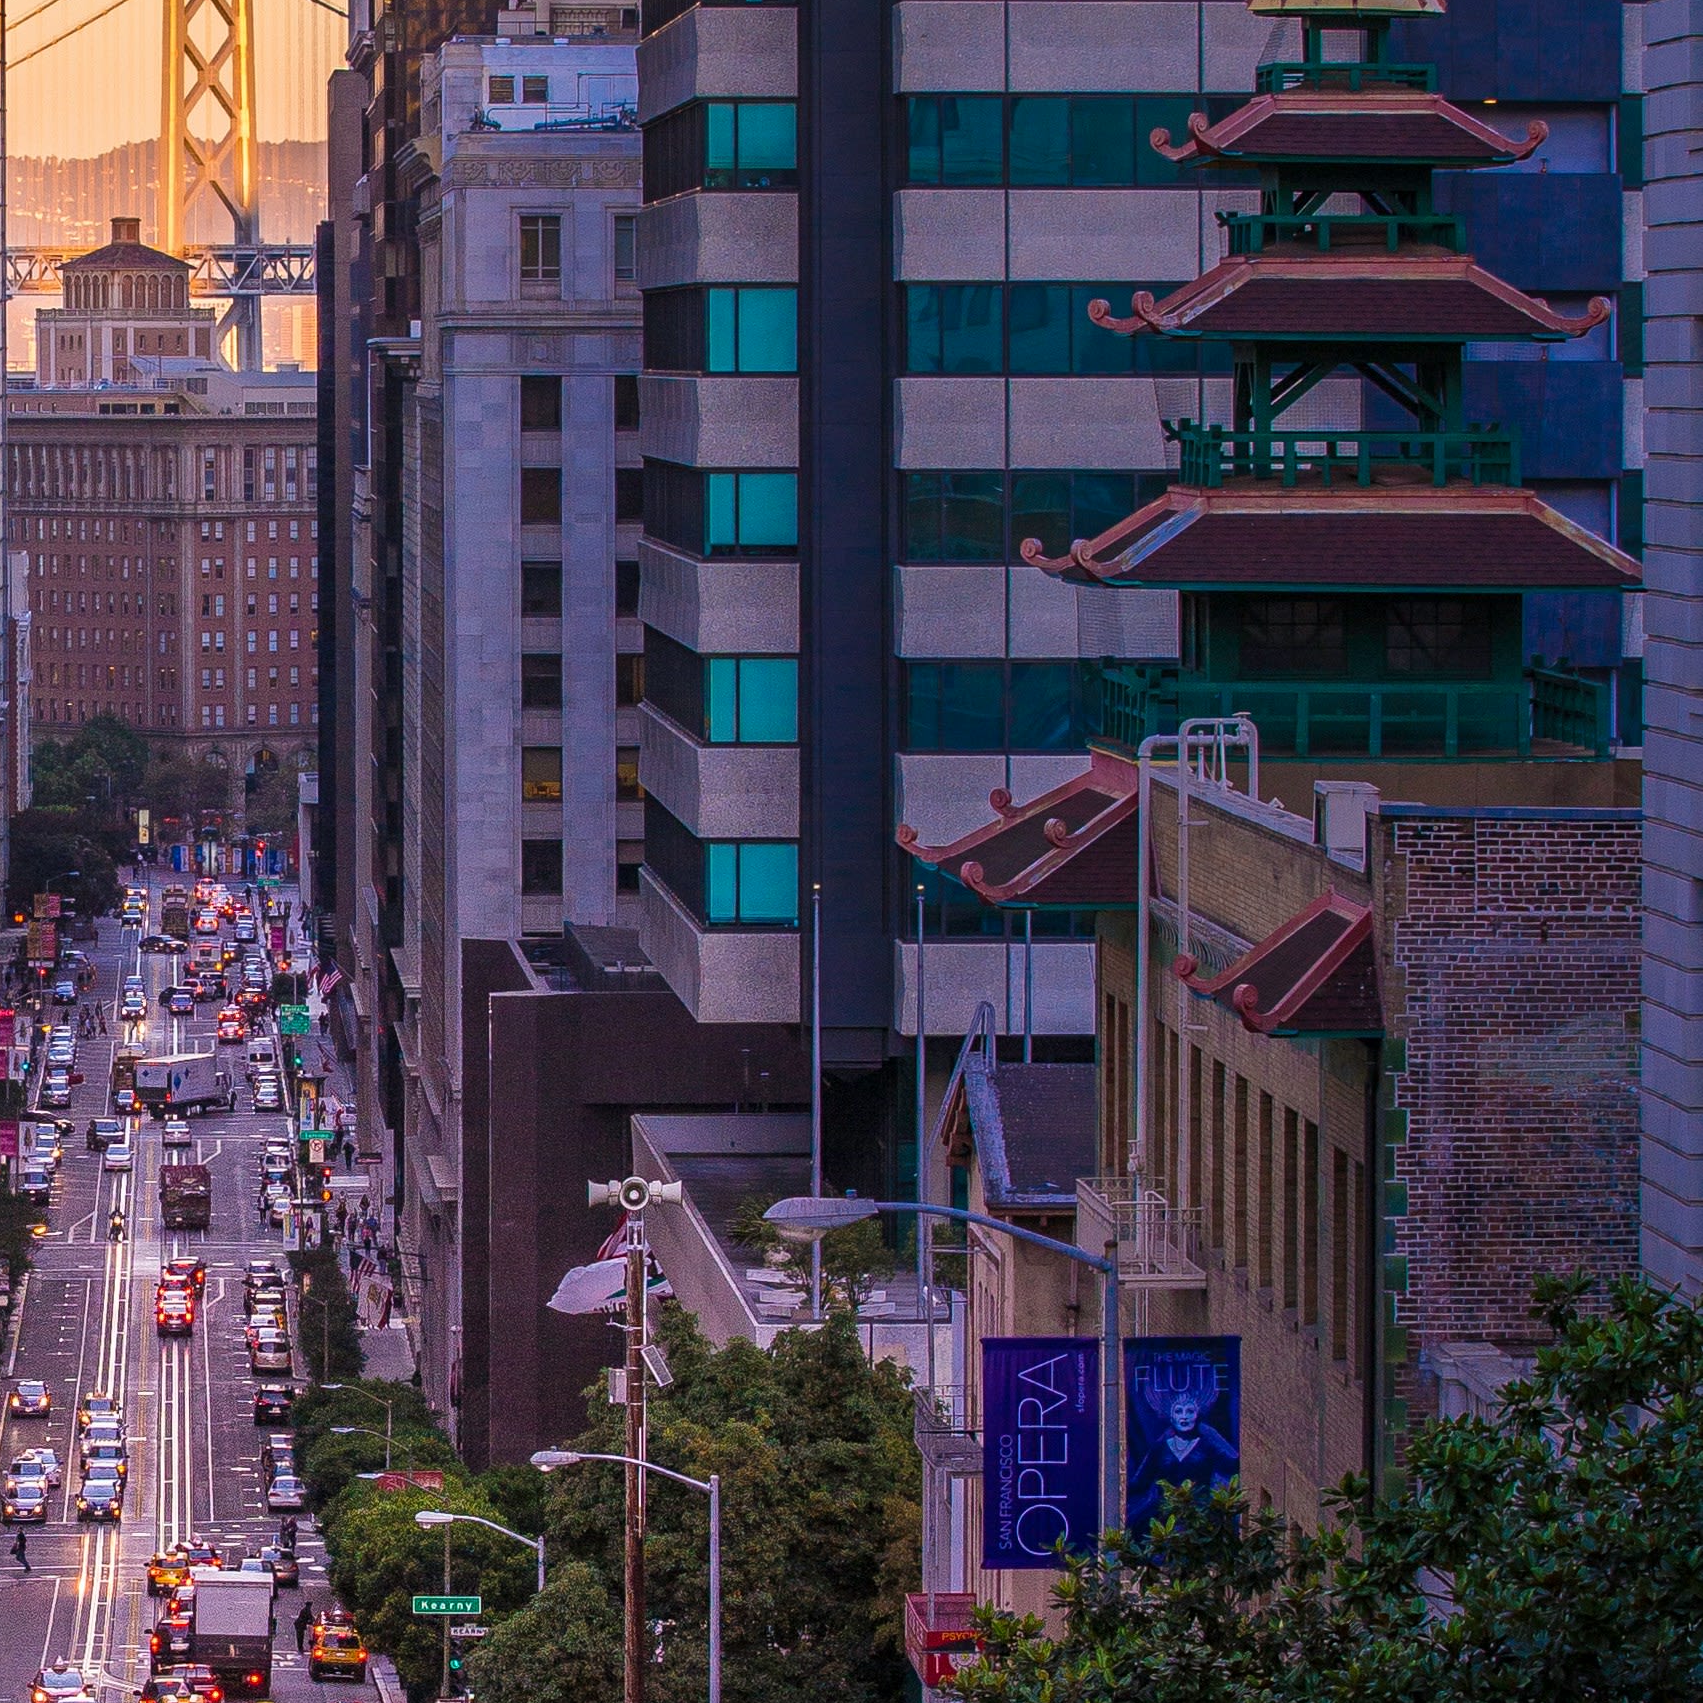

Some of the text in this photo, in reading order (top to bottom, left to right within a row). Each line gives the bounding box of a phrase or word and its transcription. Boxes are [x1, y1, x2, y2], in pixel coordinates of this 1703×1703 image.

[1134, 1363, 1229, 1392] FLUTE
[1153, 1352, 1210, 1362] THE MAGIC
[1074, 1353, 1084, 1413] sfopera.com
[1016, 1354, 1069, 1556] OPERA
[999, 1434, 1013, 1550] SAN FRANCISCO
[420, 1601, 473, 1612] Kearny
